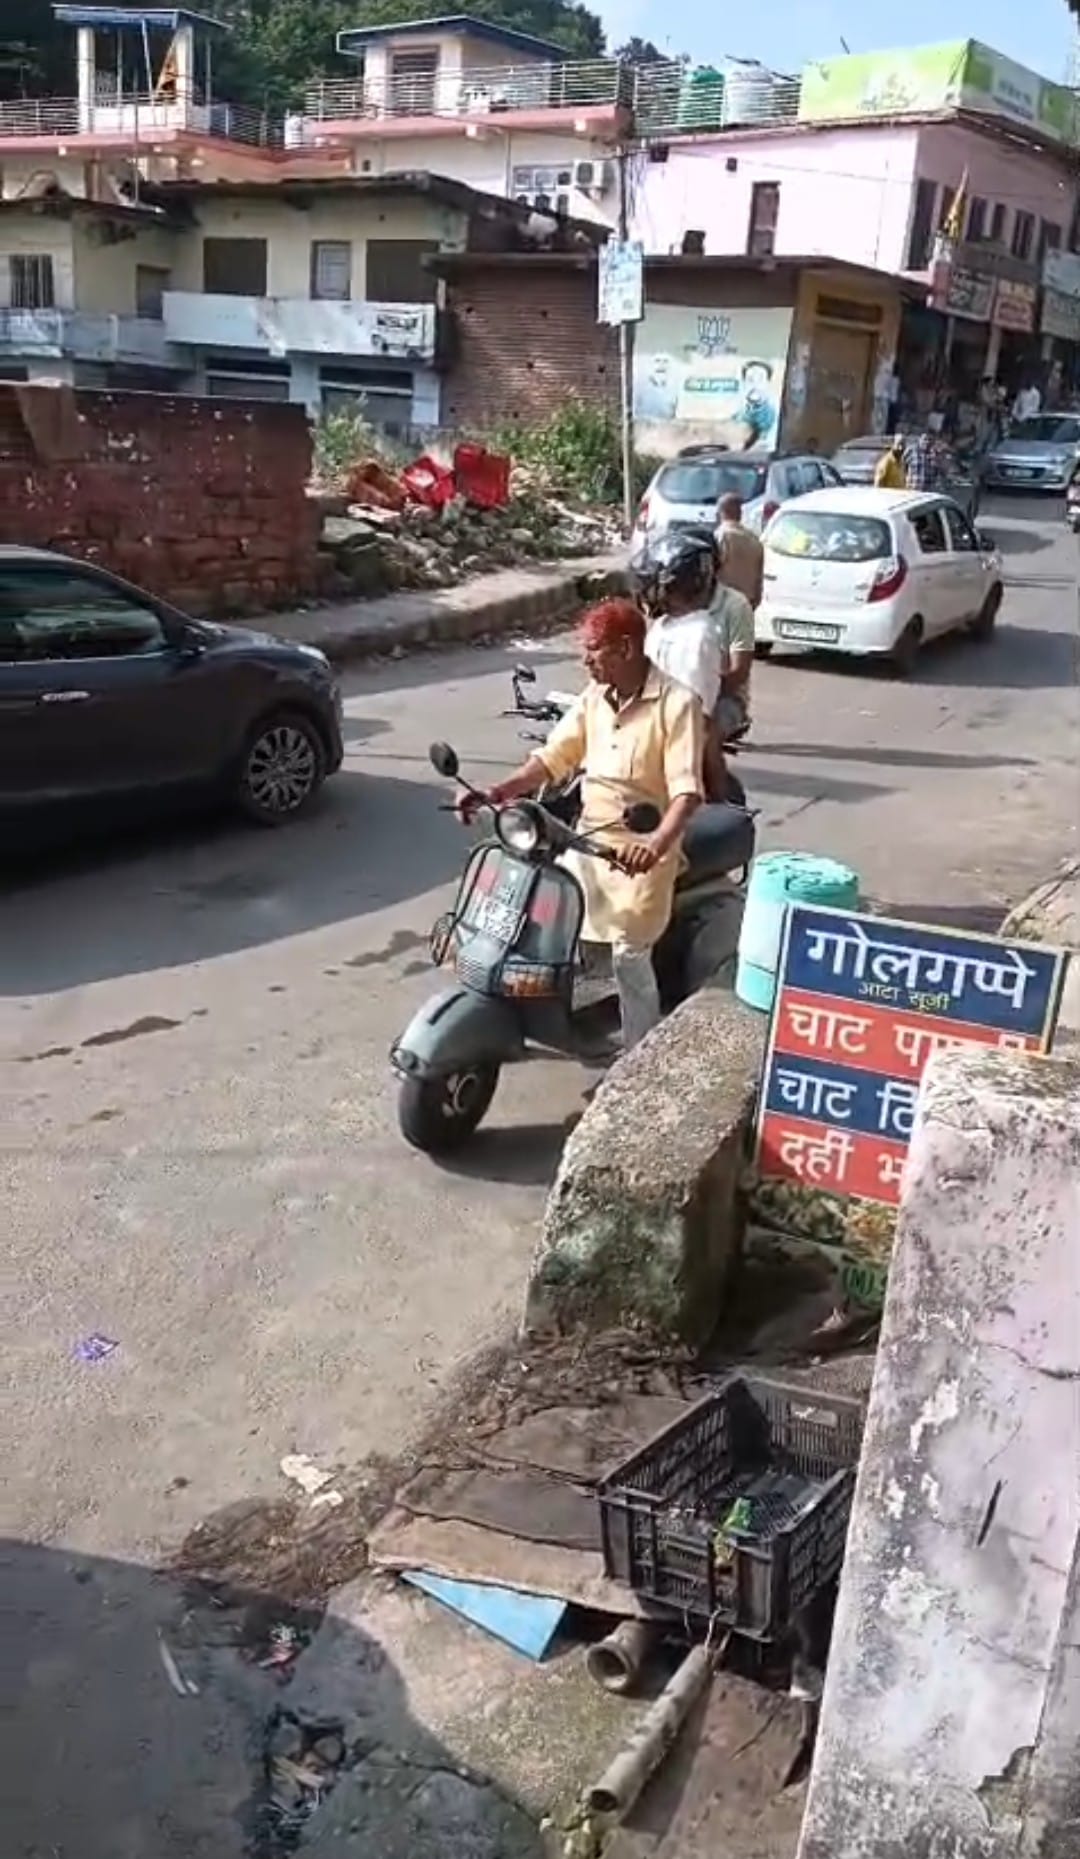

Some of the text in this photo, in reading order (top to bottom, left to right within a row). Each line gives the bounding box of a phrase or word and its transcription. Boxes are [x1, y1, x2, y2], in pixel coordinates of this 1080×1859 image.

[806, 921, 1036, 1009] गोलगप्पे
[858, 982, 902, 1001] आटा
[786, 1001, 874, 1053] चाट
[777, 1068, 858, 1119] चाट
[780, 1129, 856, 1181] दही
